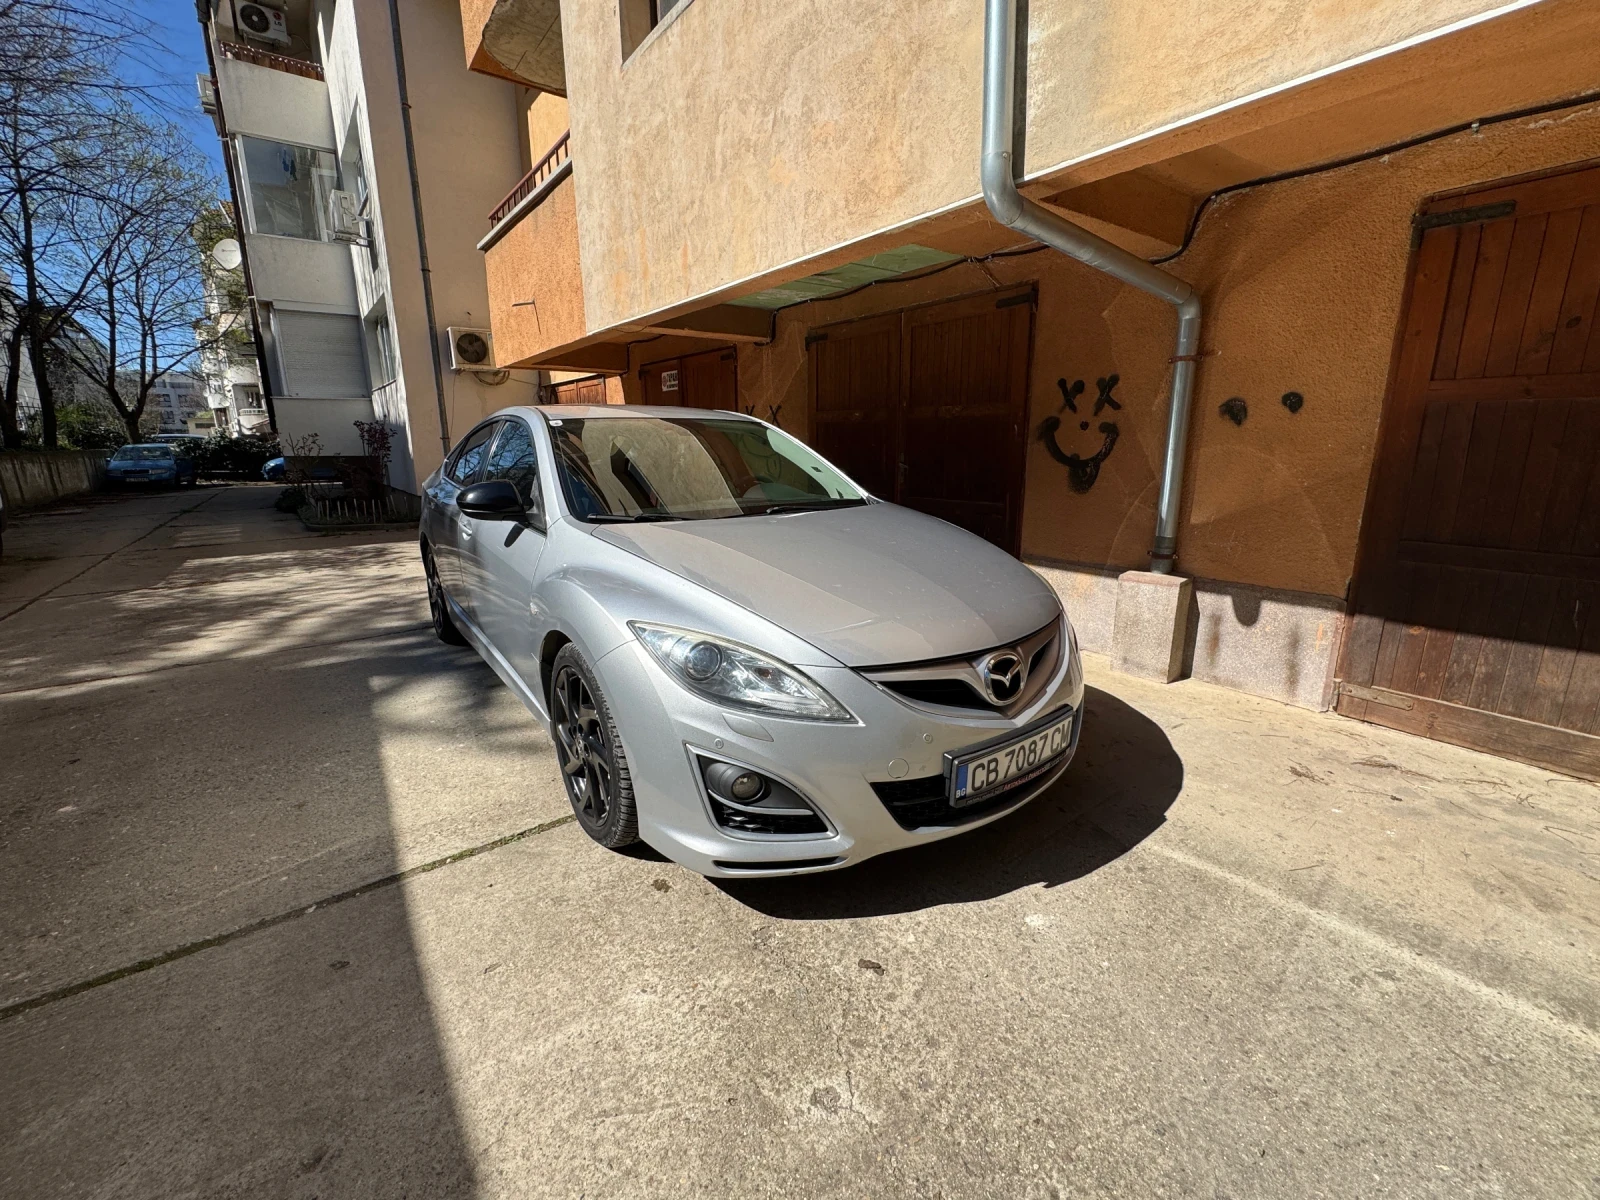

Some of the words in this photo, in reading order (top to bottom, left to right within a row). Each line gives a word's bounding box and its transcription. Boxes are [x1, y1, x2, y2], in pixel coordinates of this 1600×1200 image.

[972, 757, 999, 792] CB
[1004, 732, 1048, 779] 7087
[1050, 719, 1071, 754] CM
[955, 787, 966, 799] BG
